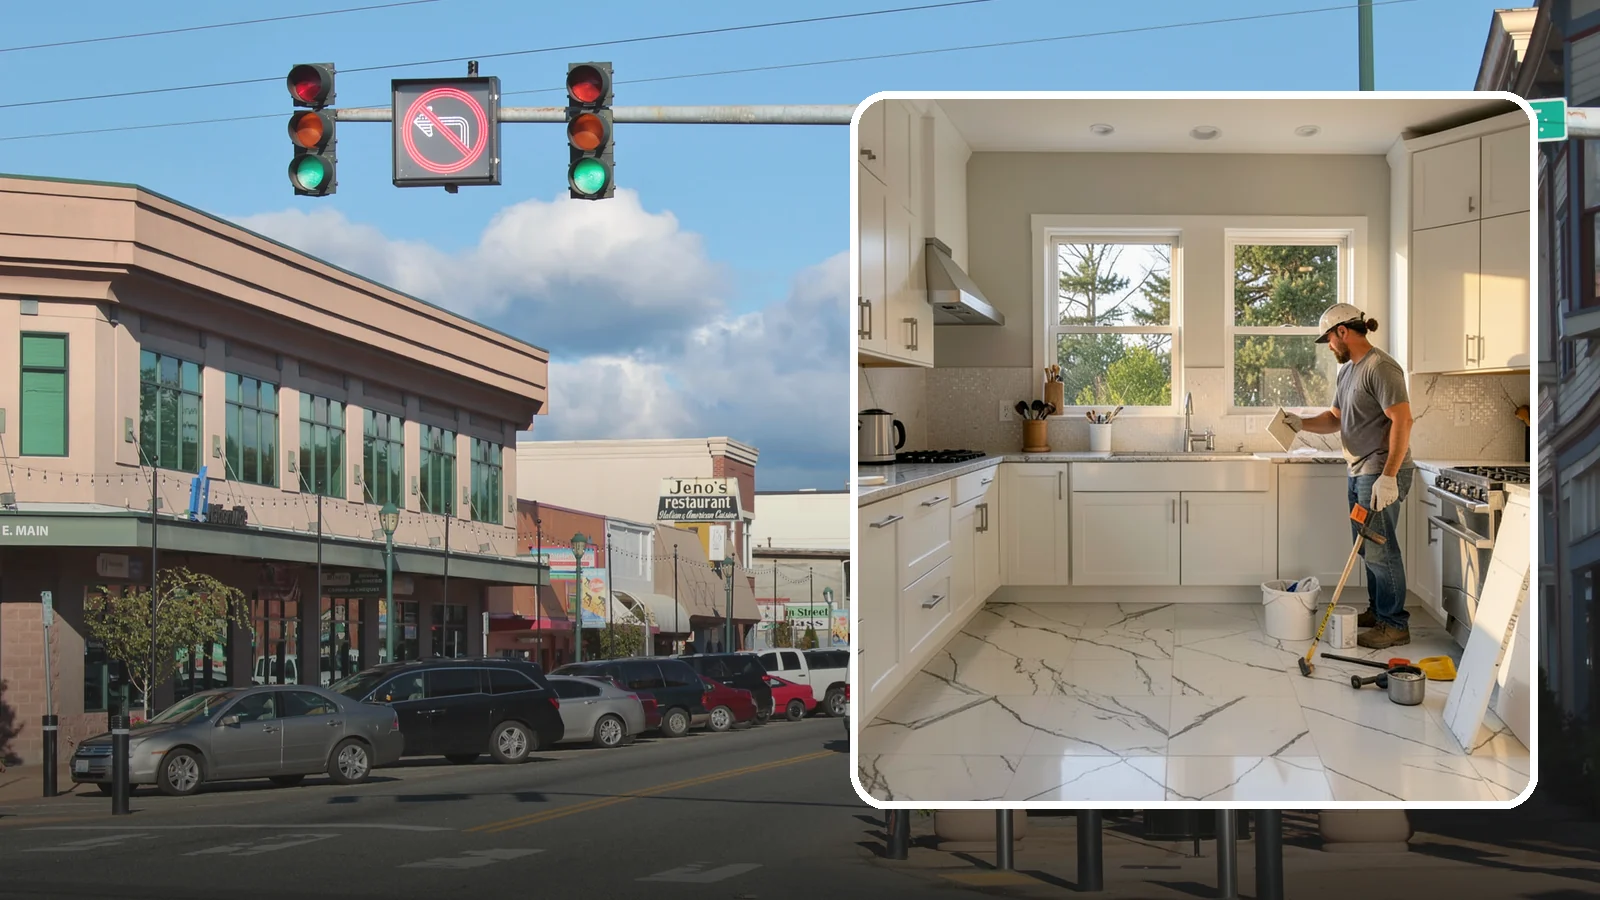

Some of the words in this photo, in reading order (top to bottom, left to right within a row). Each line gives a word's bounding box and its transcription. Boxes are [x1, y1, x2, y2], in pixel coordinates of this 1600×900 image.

[670, 480, 727, 494] Jeno's
[665, 496, 731, 509] restaurant
[658, 510, 681, 519] Italian
[686, 510, 714, 519] American
[715, 510, 738, 519] Cuisine
[2, 525, 13, 536] E.
[15, 525, 49, 536] MAIN
[797, 607, 828, 617] Street
